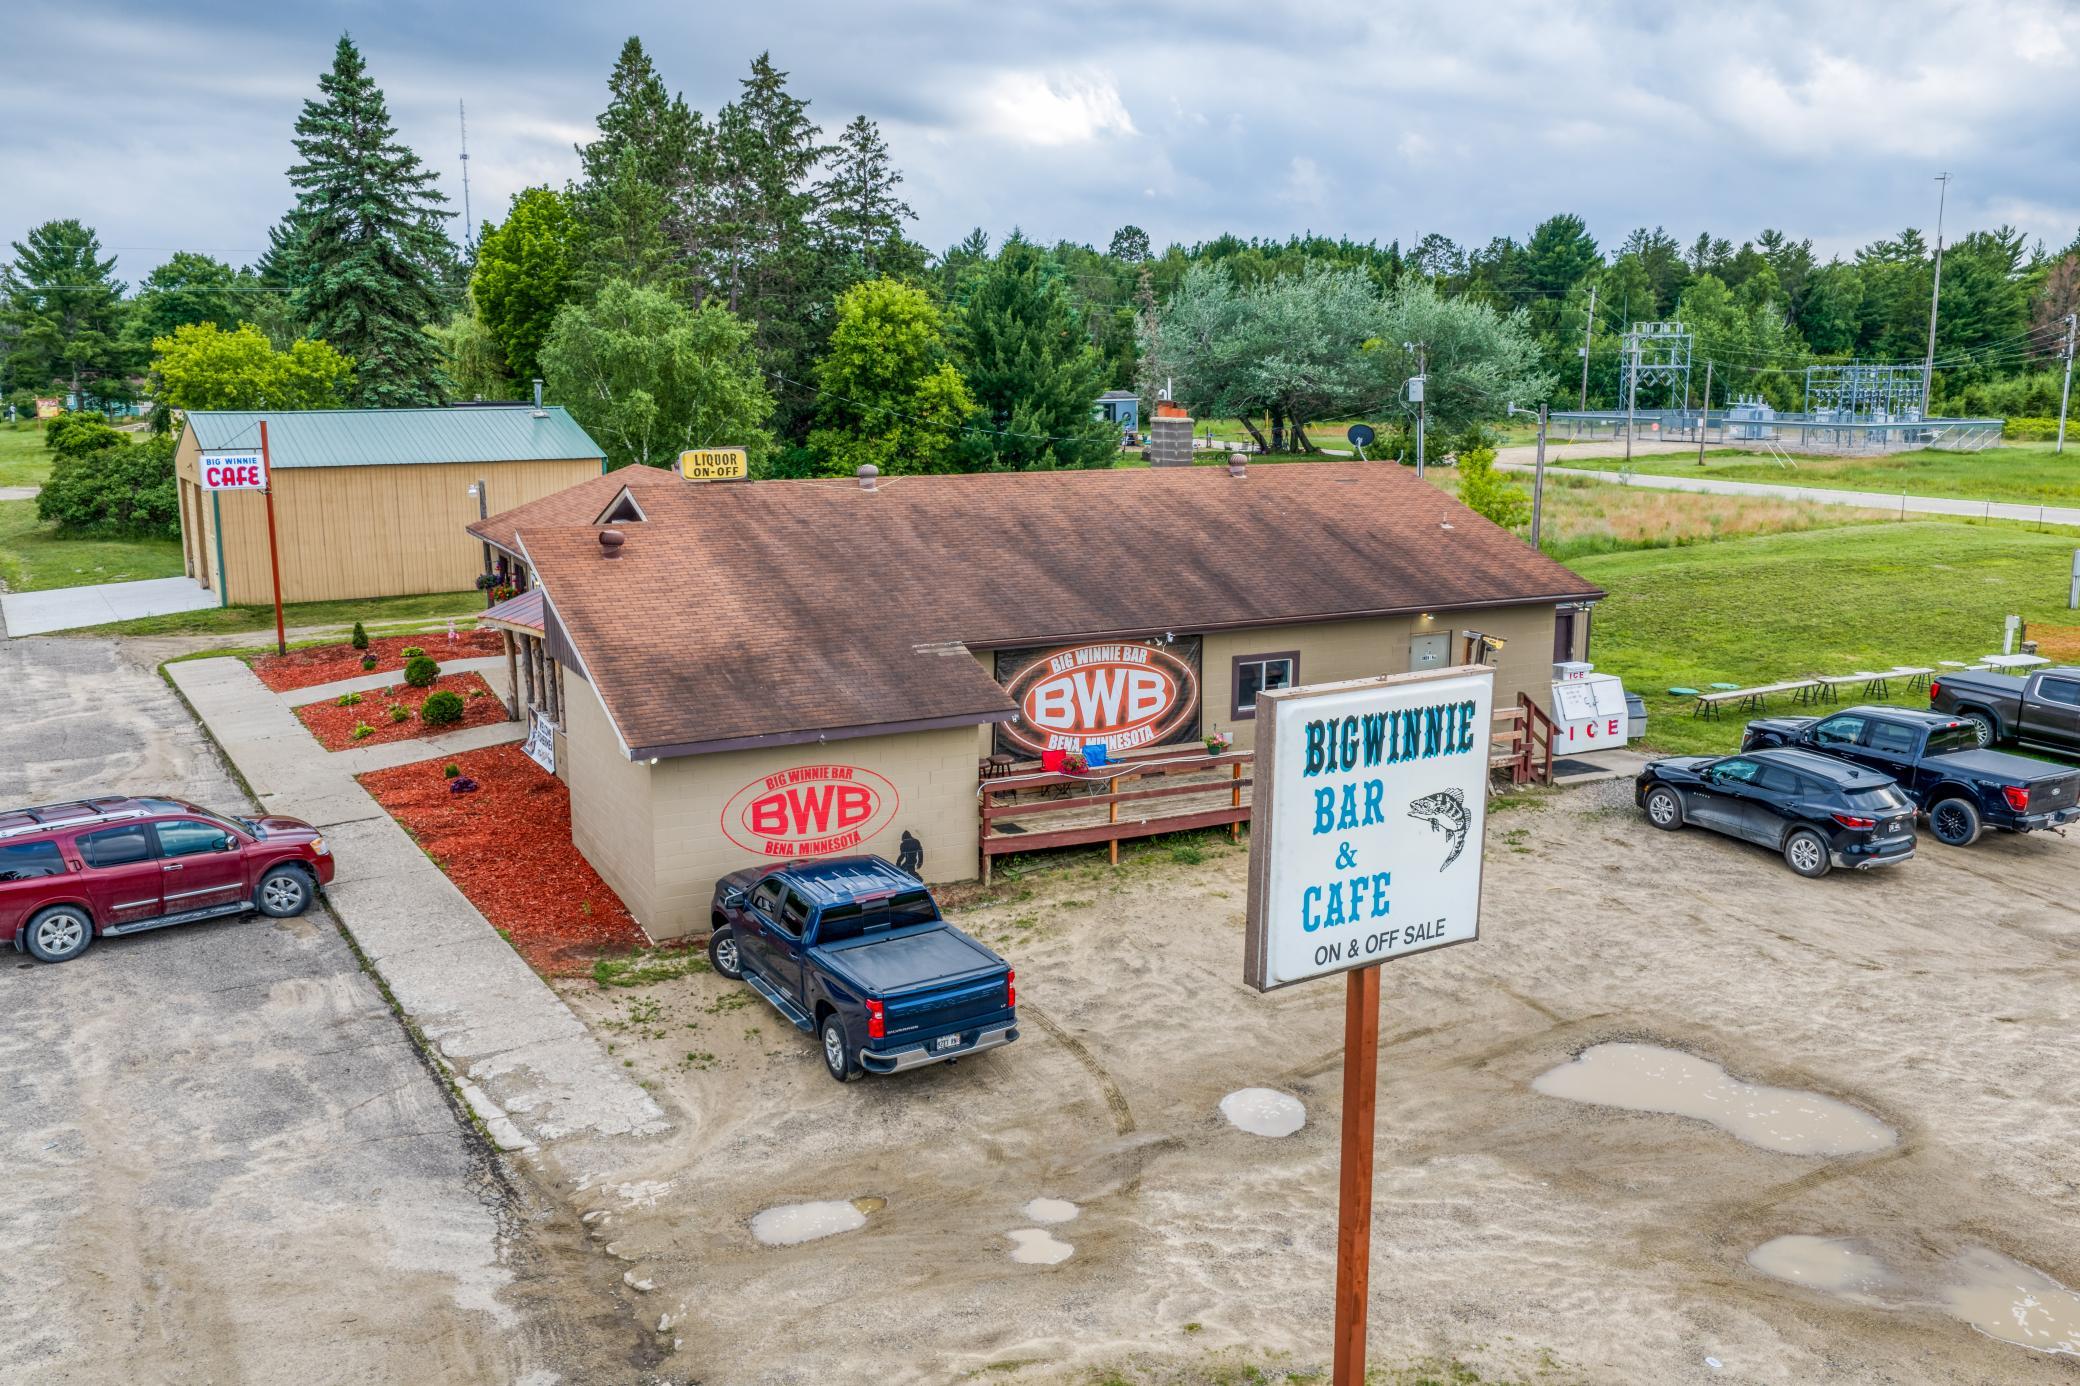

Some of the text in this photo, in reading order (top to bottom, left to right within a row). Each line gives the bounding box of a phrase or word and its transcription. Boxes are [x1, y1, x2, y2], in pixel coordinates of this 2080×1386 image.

[206, 457, 257, 466] BIG WINNIE
[693, 466, 739, 477] ON-OFF
[694, 453, 737, 467] LIQUOR
[207, 465, 260, 487] CAFE
[1051, 646, 1147, 674] BIG WINNIE BAR
[1569, 671, 1584, 680] ICE
[1034, 668, 1167, 729] BWB
[1569, 719, 1619, 741] ICE
[766, 767, 853, 790] BIG WINNIE BAR
[752, 785, 872, 836] BWB
[1313, 778, 1385, 835] BAR
[799, 830, 862, 855] MINNESOTA
[1335, 841, 1358, 870] &
[1302, 871, 1391, 933] CAFE
[1314, 918, 1446, 966] ON & OFF SALE
